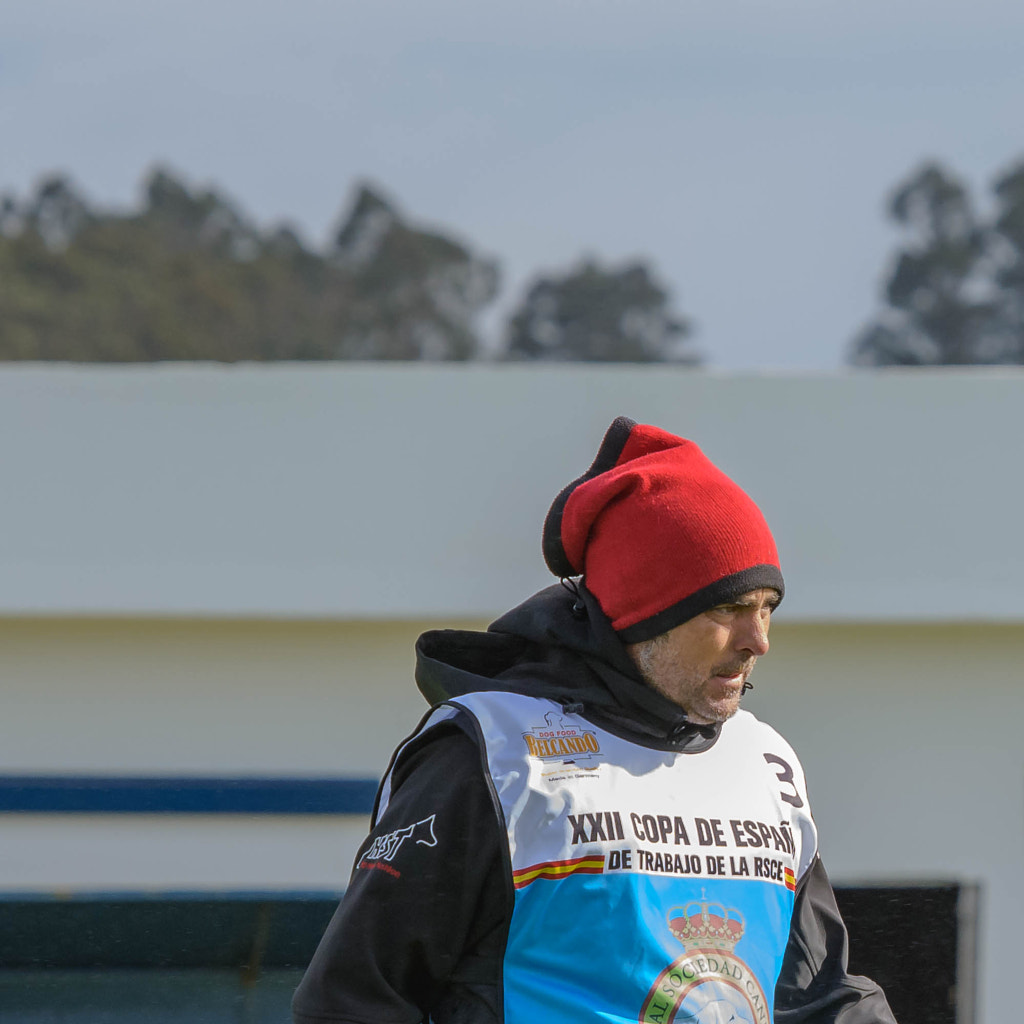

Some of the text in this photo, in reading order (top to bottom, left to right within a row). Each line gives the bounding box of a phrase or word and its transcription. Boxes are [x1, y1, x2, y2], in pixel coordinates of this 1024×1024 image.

[523, 731, 600, 757] BELCANDO
[556, 729, 577, 737] FOOD
[567, 811, 796, 860] XXII COPA DE ESPAÑ
[607, 849, 784, 882] DE TRABAJO DE LA RSCE
[661, 957, 743, 999] SOCIEDAD
